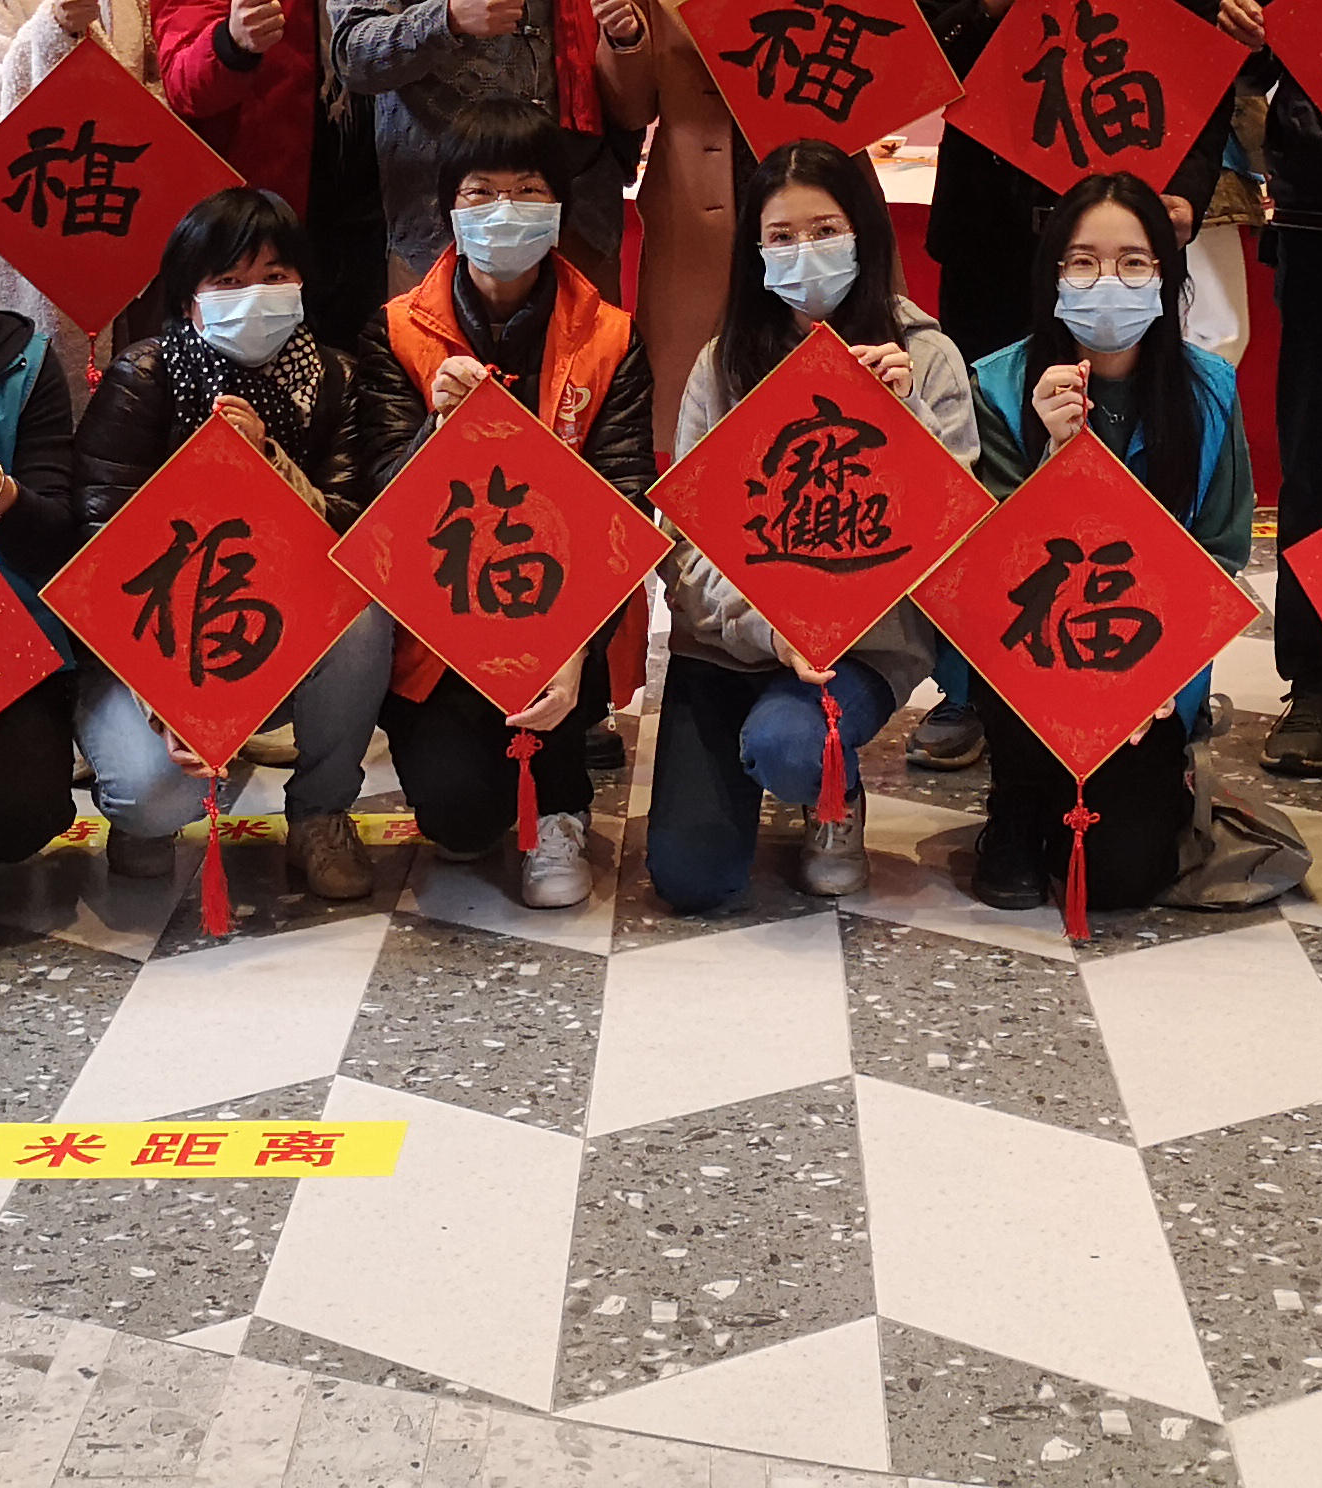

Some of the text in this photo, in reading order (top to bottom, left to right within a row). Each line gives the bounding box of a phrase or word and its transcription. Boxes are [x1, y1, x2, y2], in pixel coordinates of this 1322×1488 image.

[1022, 0, 1165, 168] 福
[1, 120, 152, 237] 福
[122, 519, 283, 686] 福
[428, 466, 563, 618] 福
[1001, 538, 1162, 671] 福
